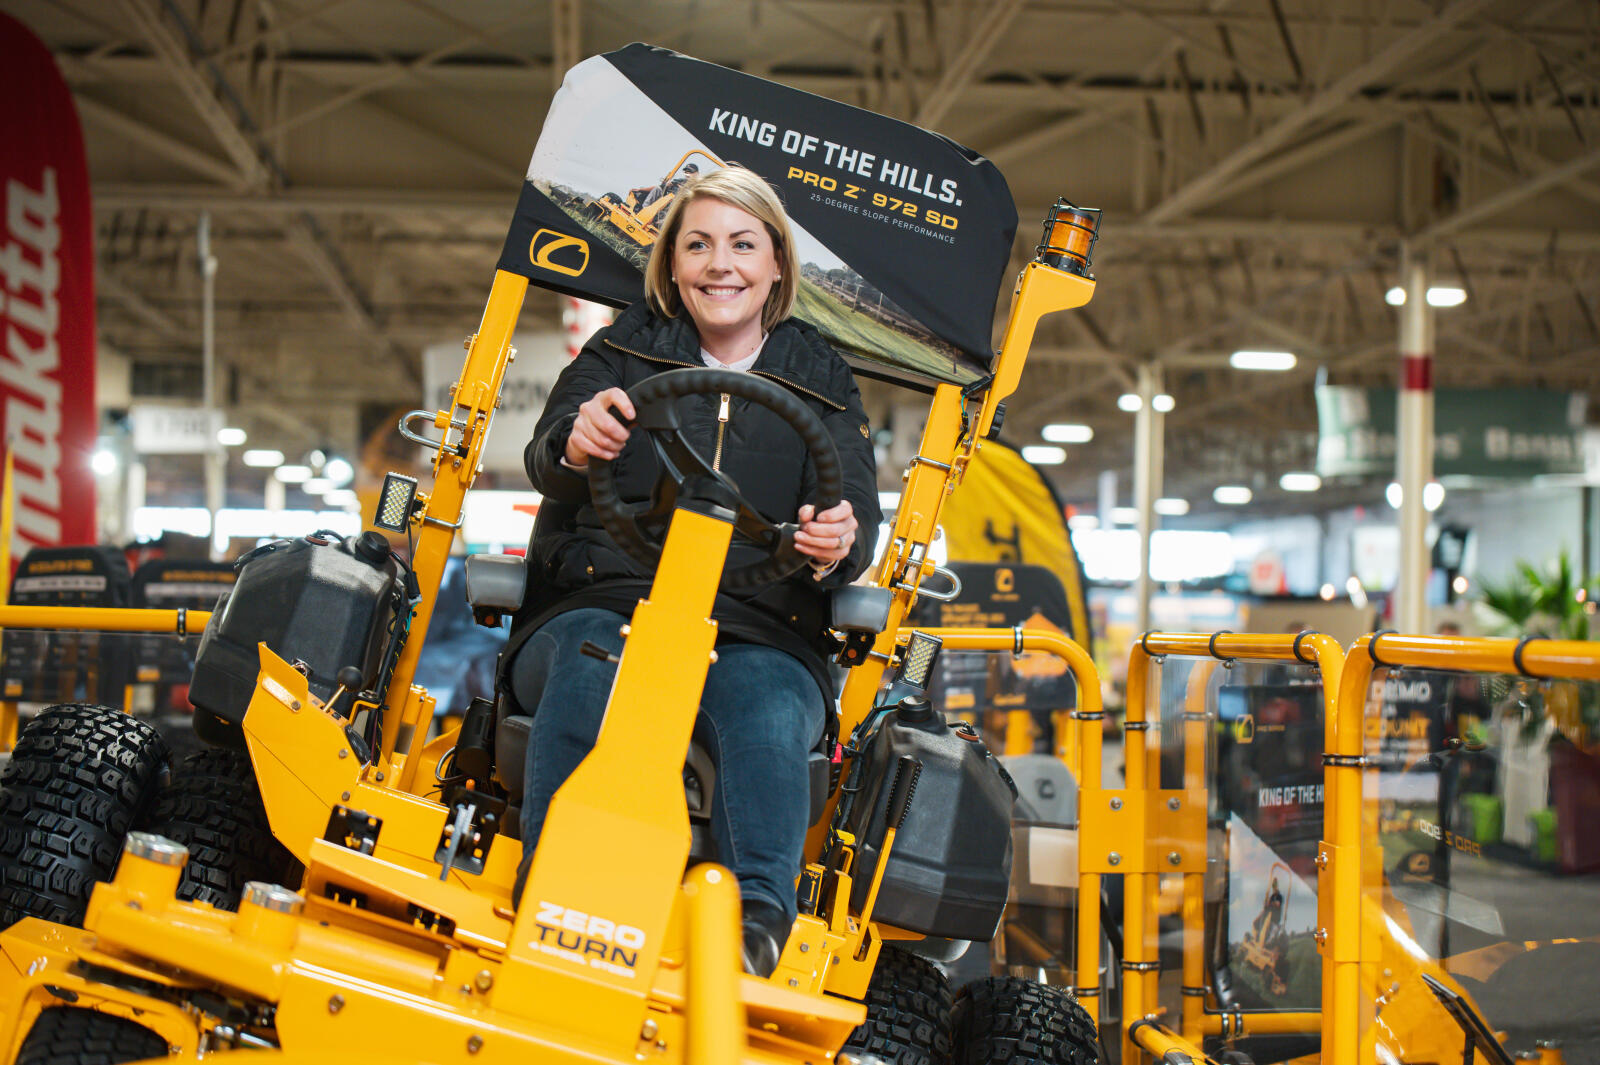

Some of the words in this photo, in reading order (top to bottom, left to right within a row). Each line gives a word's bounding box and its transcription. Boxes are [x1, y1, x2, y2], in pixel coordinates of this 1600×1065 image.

[708, 107, 777, 147] KING
[781, 129, 819, 158] OF
[823, 140, 876, 178] THE
[879, 160, 963, 207] HILLS.
[787, 166, 838, 192] PRO
[872, 192, 918, 218] 972
[924, 209, 959, 230] SD
[810, 193, 859, 214] 25-DEGREE
[862, 209, 890, 224] SLOPE
[892, 218, 956, 244] PERFORMANCE
[1371, 680, 1432, 702] DEMO
[1259, 787, 1282, 807] KING
[1283, 786, 1297, 805] OF
[1298, 784, 1315, 804] THE
[535, 900, 646, 950] ZERO
[535, 923, 638, 967] TURN
